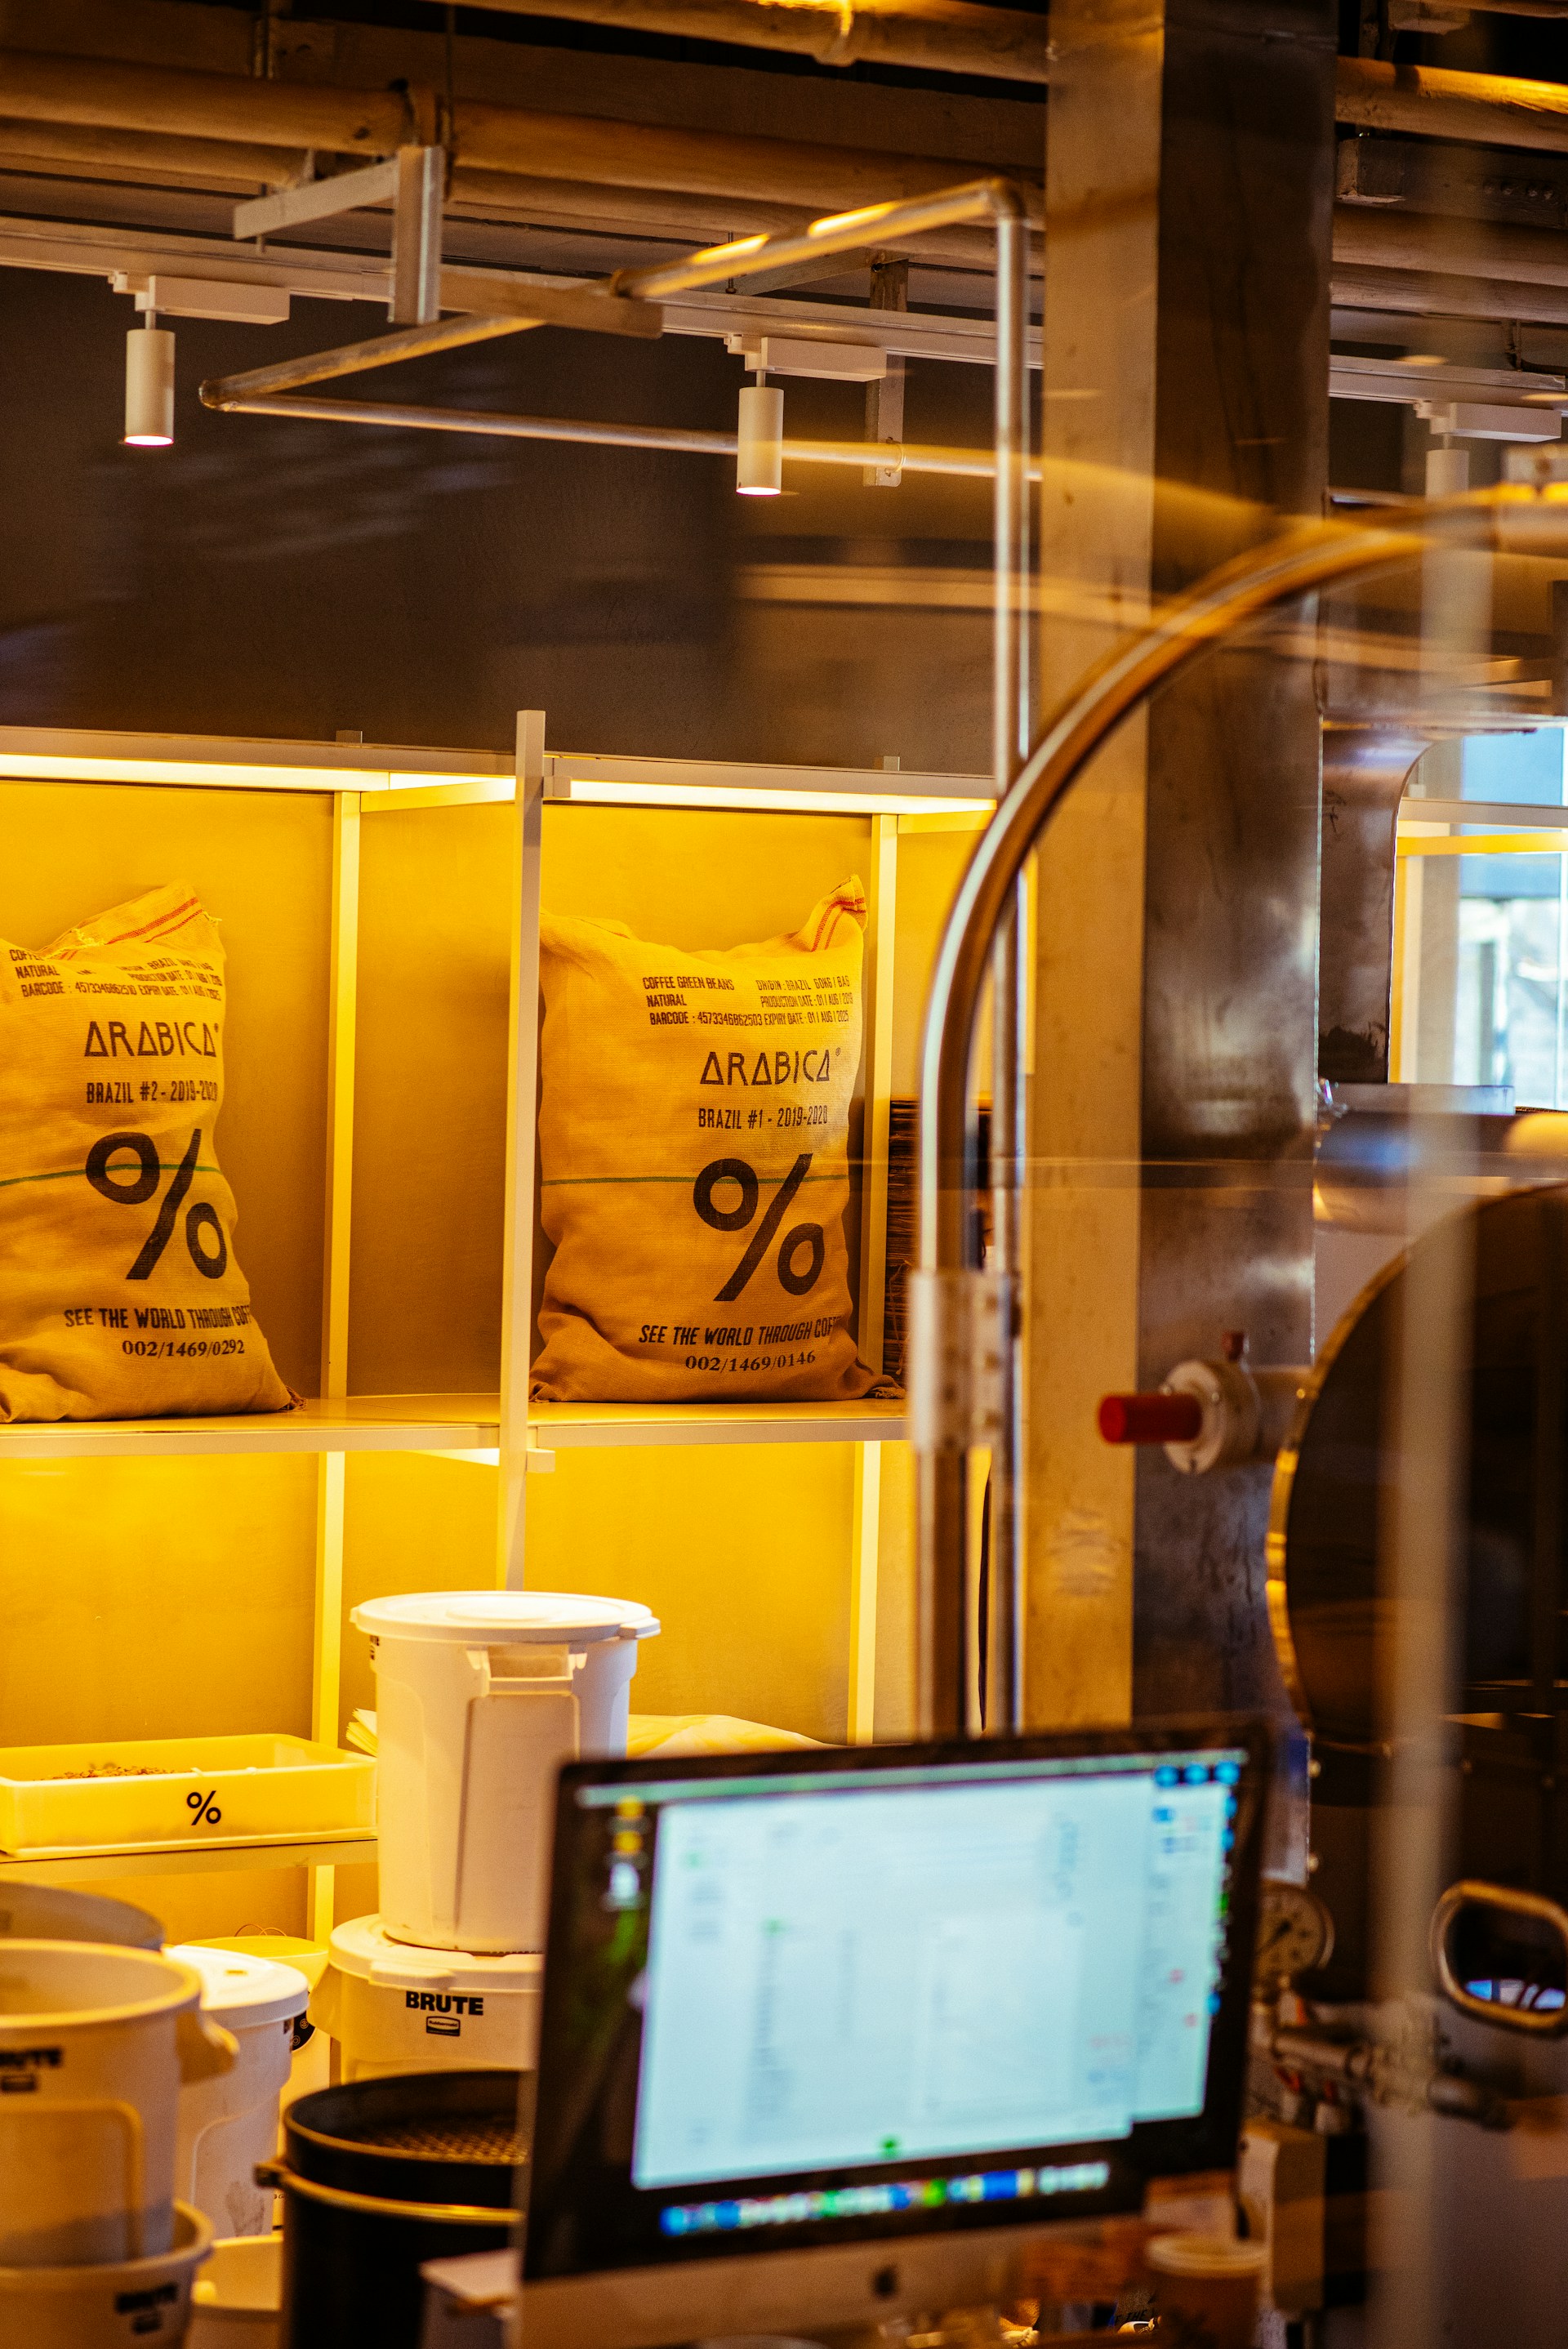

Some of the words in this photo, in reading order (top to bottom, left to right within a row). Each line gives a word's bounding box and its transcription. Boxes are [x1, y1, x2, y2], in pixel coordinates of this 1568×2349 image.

[147, 957, 178, 969] BRAZIL
[15, 965, 60, 979] NATURAL
[21, 981, 65, 997] BARCODE
[642, 976, 676, 990] COFFEE
[676, 976, 706, 988] GREEN
[706, 978, 735, 990] BEANS
[756, 980, 782, 990] ORIGIN
[786, 980, 812, 991] BRAZIL
[646, 994, 688, 1008] NATURAL
[760, 996, 798, 1008] PRODUCTION
[797, 995, 813, 1006] DATE
[828, 993, 840, 1005] AUG
[650, 1011, 689, 1026] BARCODE
[697, 1011, 763, 1027] 4573346862503
[764, 1013, 786, 1026] EXPIRY
[787, 1013, 804, 1024] DATE
[821, 1010, 833, 1023] AUG
[87, 1081, 134, 1103] BRAZIL
[139, 1081, 158, 1101] #2
[698, 1108, 742, 1130] BRAZIL
[747, 1109, 763, 1129] #1
[777, 1105, 828, 1128] 2019-2020
[64, 1308, 94, 1327] SEE
[98, 1308, 129, 1329] THE
[134, 1308, 186, 1329] WORLD
[187, 1308, 234, 1329] THROUGH
[639, 1325, 668, 1344] SEE
[673, 1326, 701, 1345] THE
[704, 1326, 753, 1346] WORLD
[758, 1321, 813, 1345] THROUGH
[122, 1339, 244, 1358] 002/1469/0292
[684, 1349, 816, 1374] 002/1469/0146
[406, 1990, 483, 2016] BRUTE
